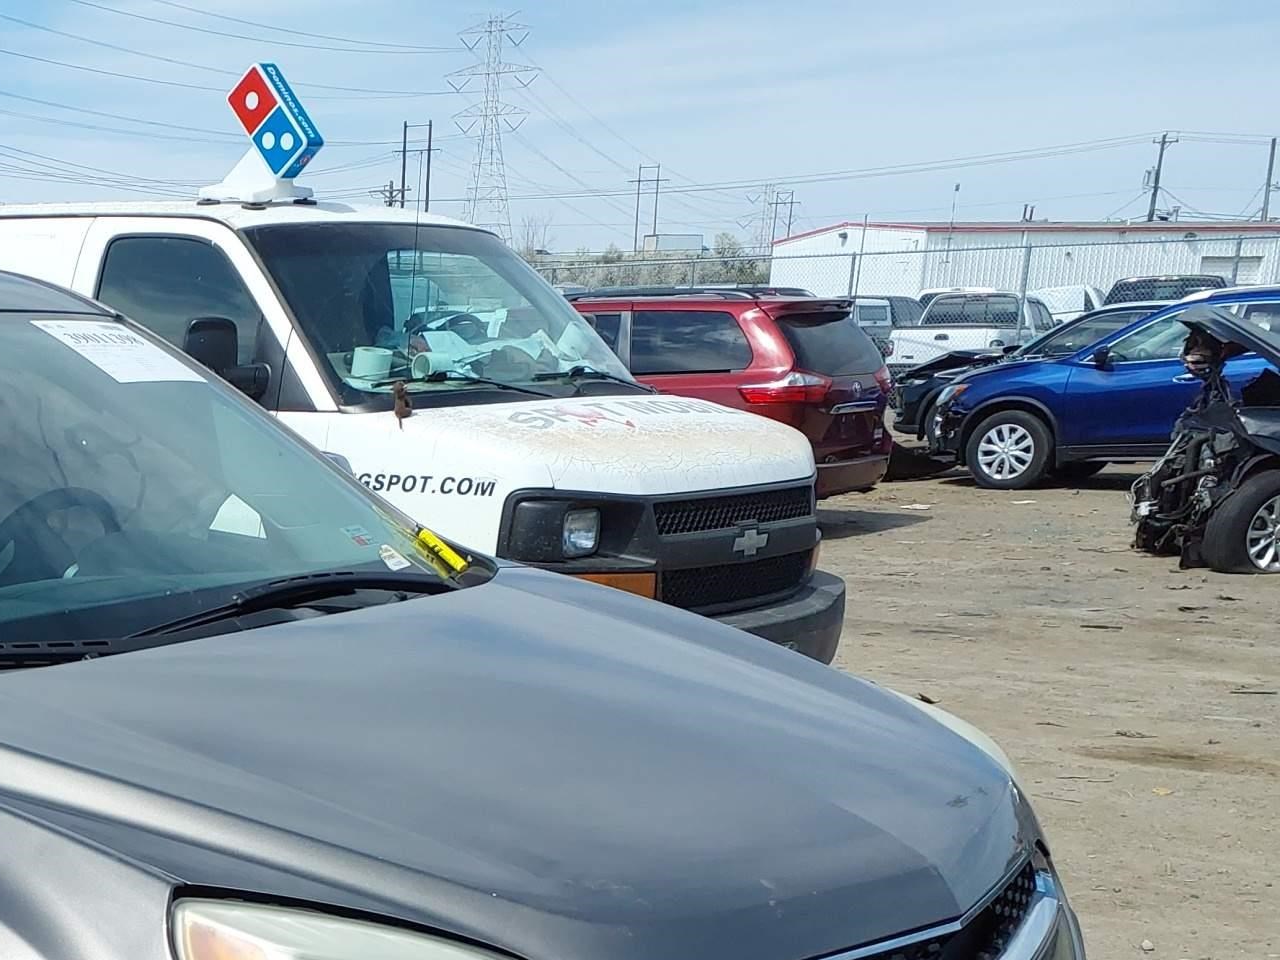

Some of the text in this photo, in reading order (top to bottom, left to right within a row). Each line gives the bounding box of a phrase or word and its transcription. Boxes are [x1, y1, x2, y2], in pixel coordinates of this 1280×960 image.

[266, 66, 315, 138] Dominos.com
[508, 400, 744, 430] SPT MOBIL
[353, 472, 497, 497] GSPOT.COM
